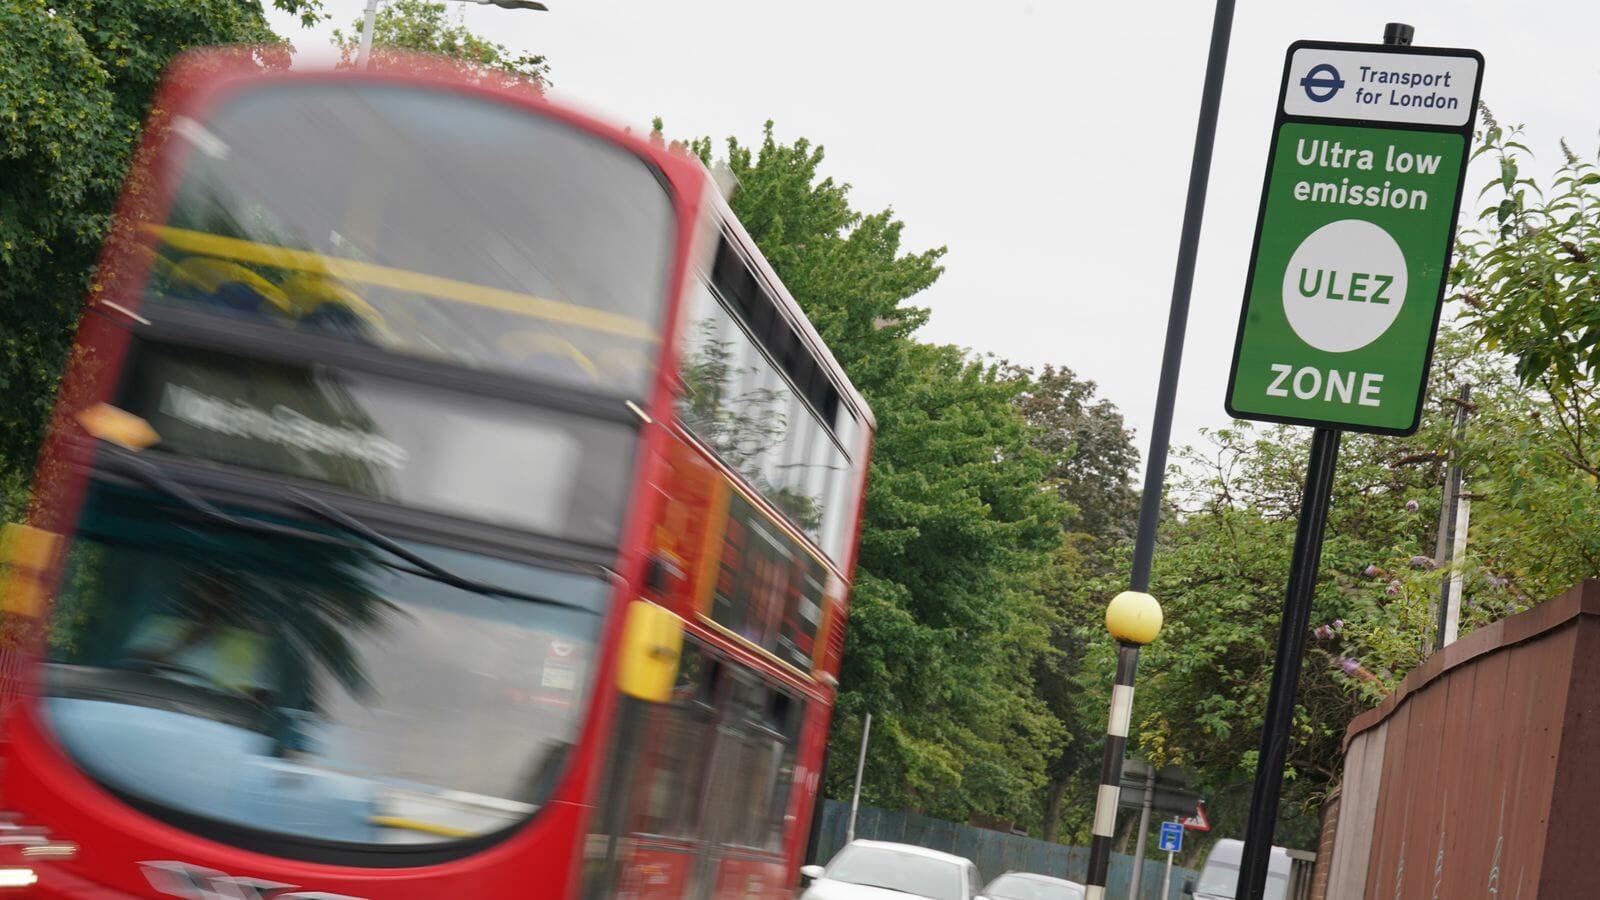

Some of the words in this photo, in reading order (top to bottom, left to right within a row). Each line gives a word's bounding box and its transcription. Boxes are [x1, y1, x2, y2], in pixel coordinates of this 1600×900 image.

[1359, 66, 1451, 88] Transport
[1355, 87, 1382, 105] for
[1389, 90, 1458, 110] London
[1295, 138, 1374, 171] Ultra
[1385, 145, 1441, 175] low
[1293, 179, 1428, 210] emission
[1298, 267, 1394, 305] ULEZ
[1266, 363, 1384, 407] ZONE
